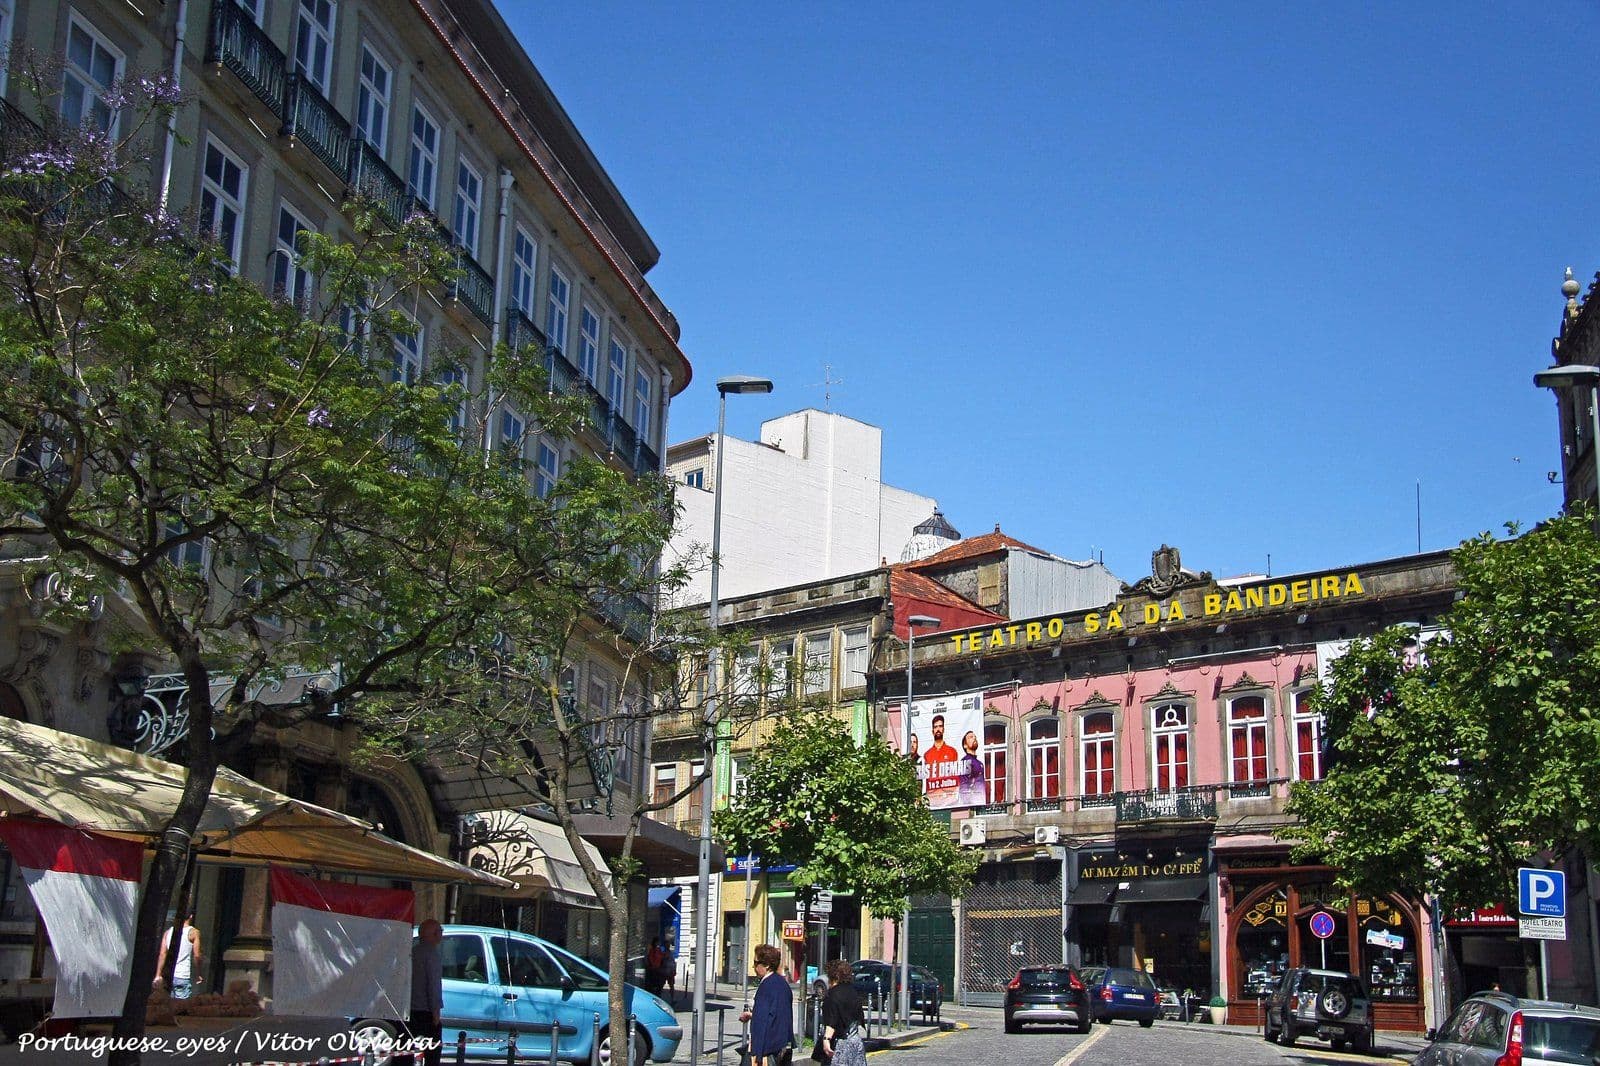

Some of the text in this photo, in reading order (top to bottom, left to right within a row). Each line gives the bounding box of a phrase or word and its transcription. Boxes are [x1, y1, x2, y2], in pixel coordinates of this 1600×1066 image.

[951, 573, 1365, 654] TEATRO SÁ DA BANDEIRA
[1529, 873, 1555, 911] P
[1541, 919, 1563, 928] TEATRO
